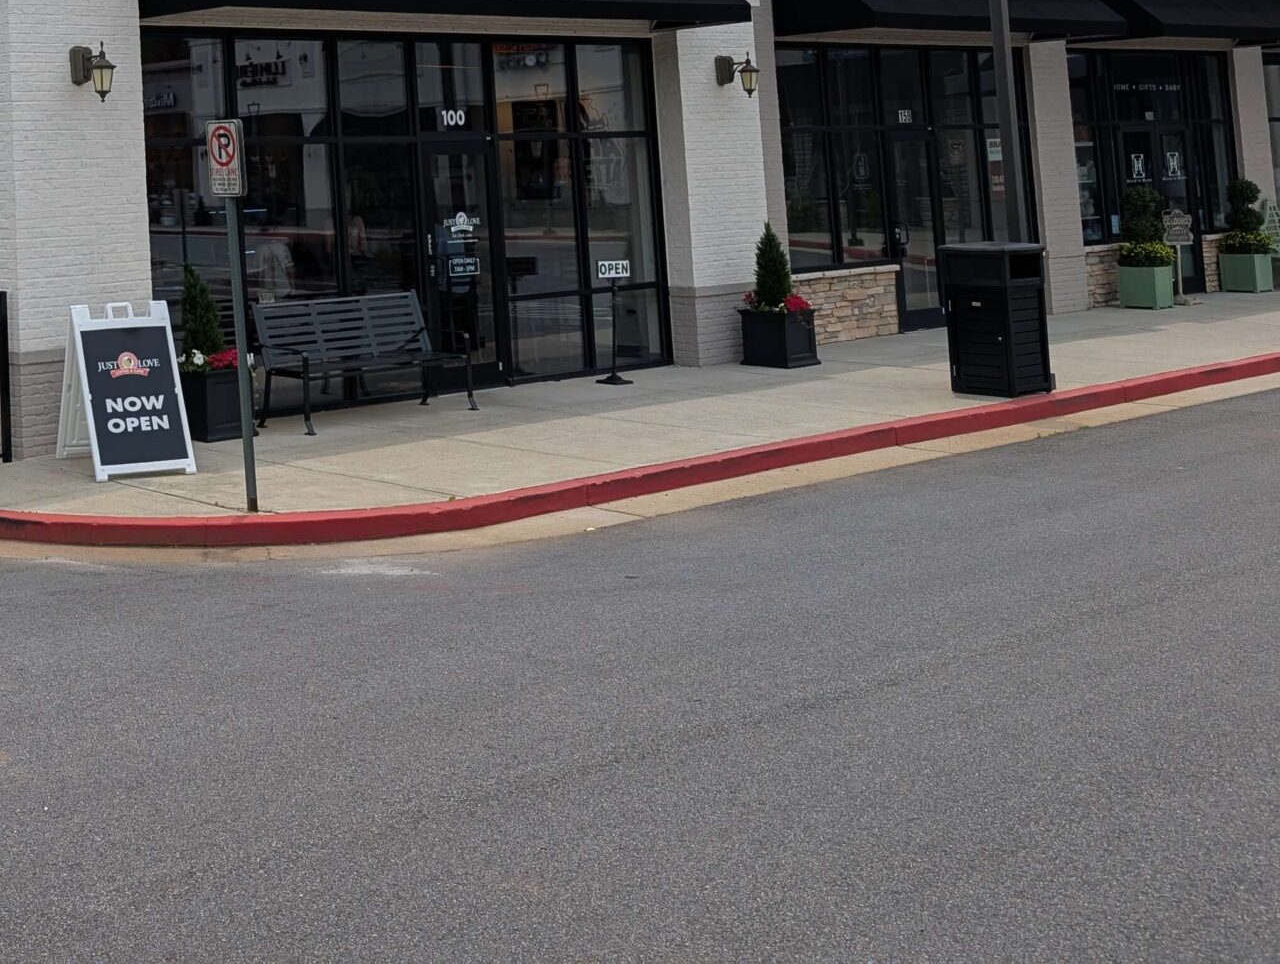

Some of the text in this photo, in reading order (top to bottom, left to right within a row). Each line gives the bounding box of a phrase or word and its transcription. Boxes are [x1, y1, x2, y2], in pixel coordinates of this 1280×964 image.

[441, 109, 465, 126] 100
[443, 216, 481, 227] JUST LOVE
[599, 262, 629, 276] OPEN
[97, 361, 118, 373] JUST
[138, 358, 160, 367] LOVE
[105, 394, 165, 413] NOW
[107, 415, 170, 434] OPEN
